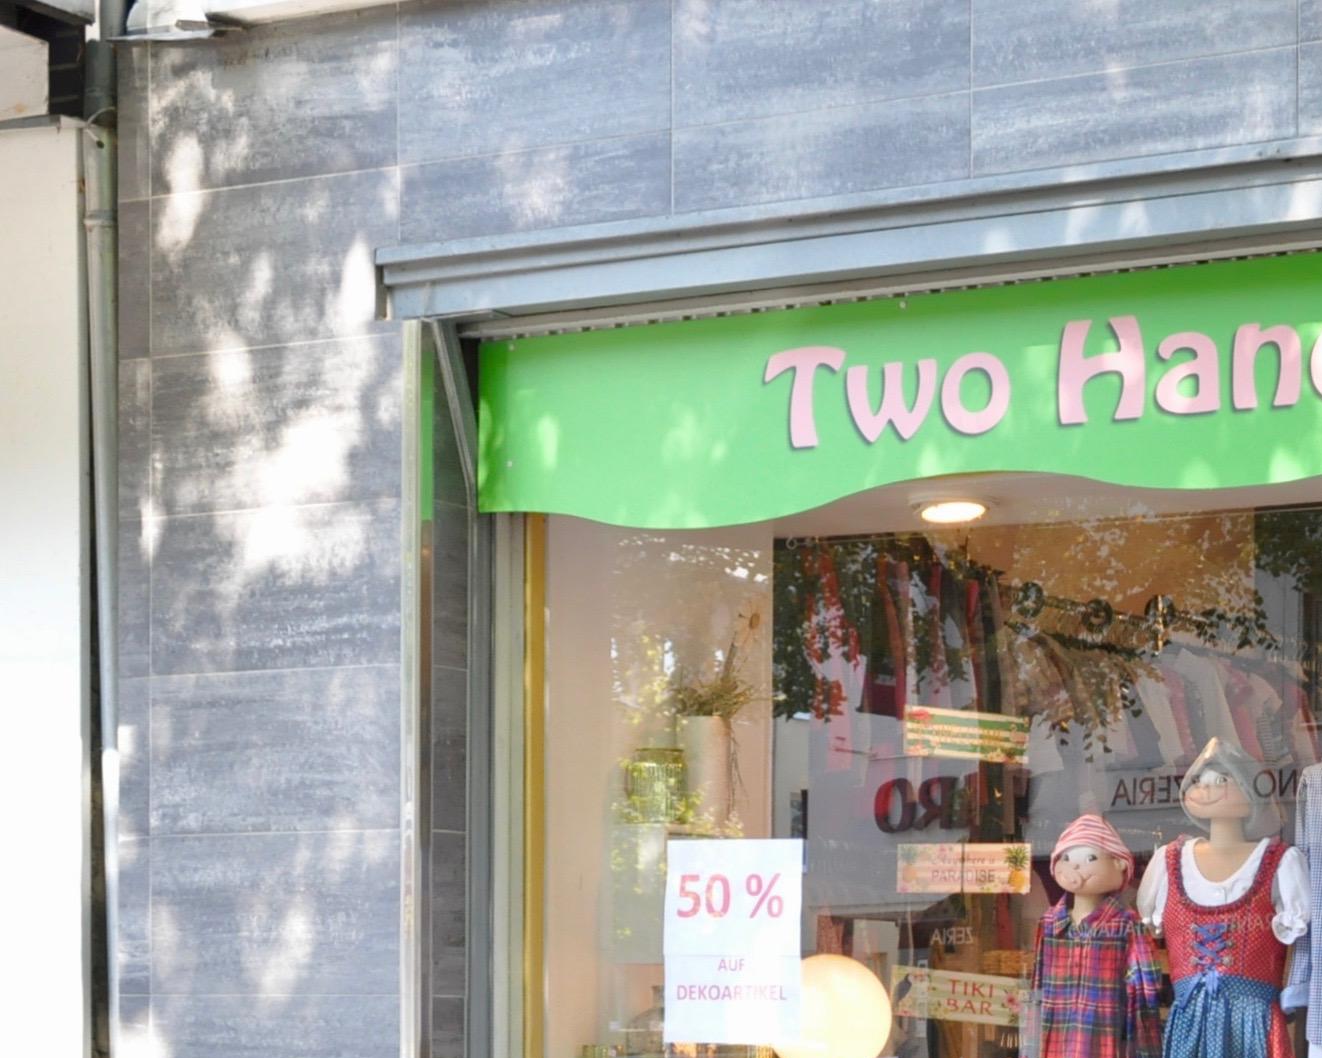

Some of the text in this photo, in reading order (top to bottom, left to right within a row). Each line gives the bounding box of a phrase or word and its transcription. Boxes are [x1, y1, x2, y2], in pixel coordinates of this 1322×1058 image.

[763, 345, 1011, 448] Two
[931, 869, 996, 883] PARADISE
[676, 873, 784, 918] 50 %
[717, 958, 745, 971] AUF
[676, 984, 788, 1001] DEKOARTIKEL
[950, 978, 995, 999] TIKI
[946, 998, 994, 1016] BAR
